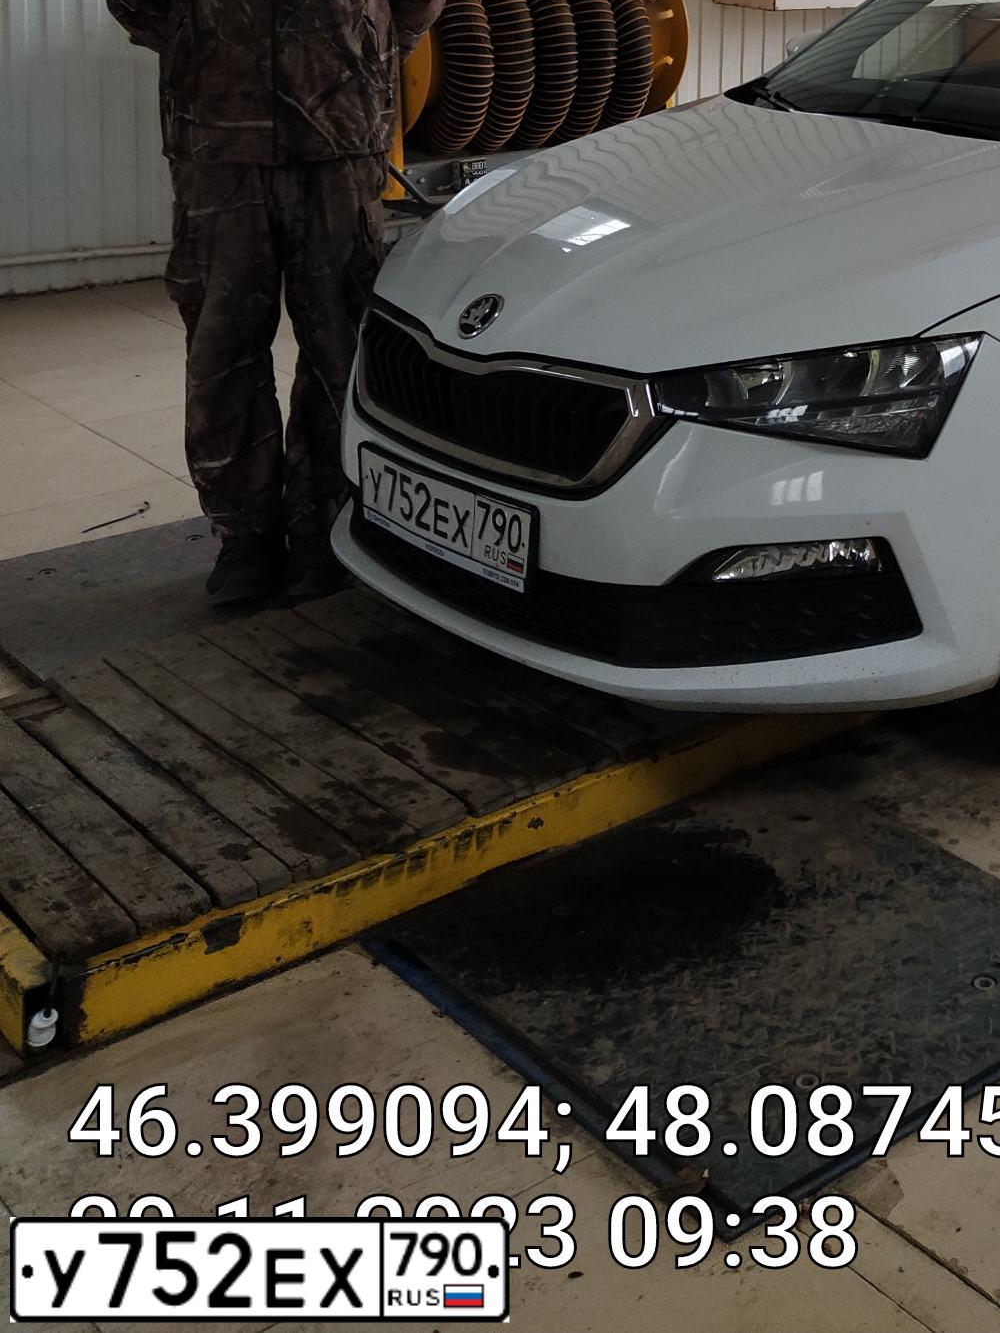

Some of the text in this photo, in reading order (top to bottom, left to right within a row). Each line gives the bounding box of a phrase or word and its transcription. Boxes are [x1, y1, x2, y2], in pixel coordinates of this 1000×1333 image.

[369, 465, 522, 554] У752ЕХ 790
[484, 544, 506, 566] RUS
